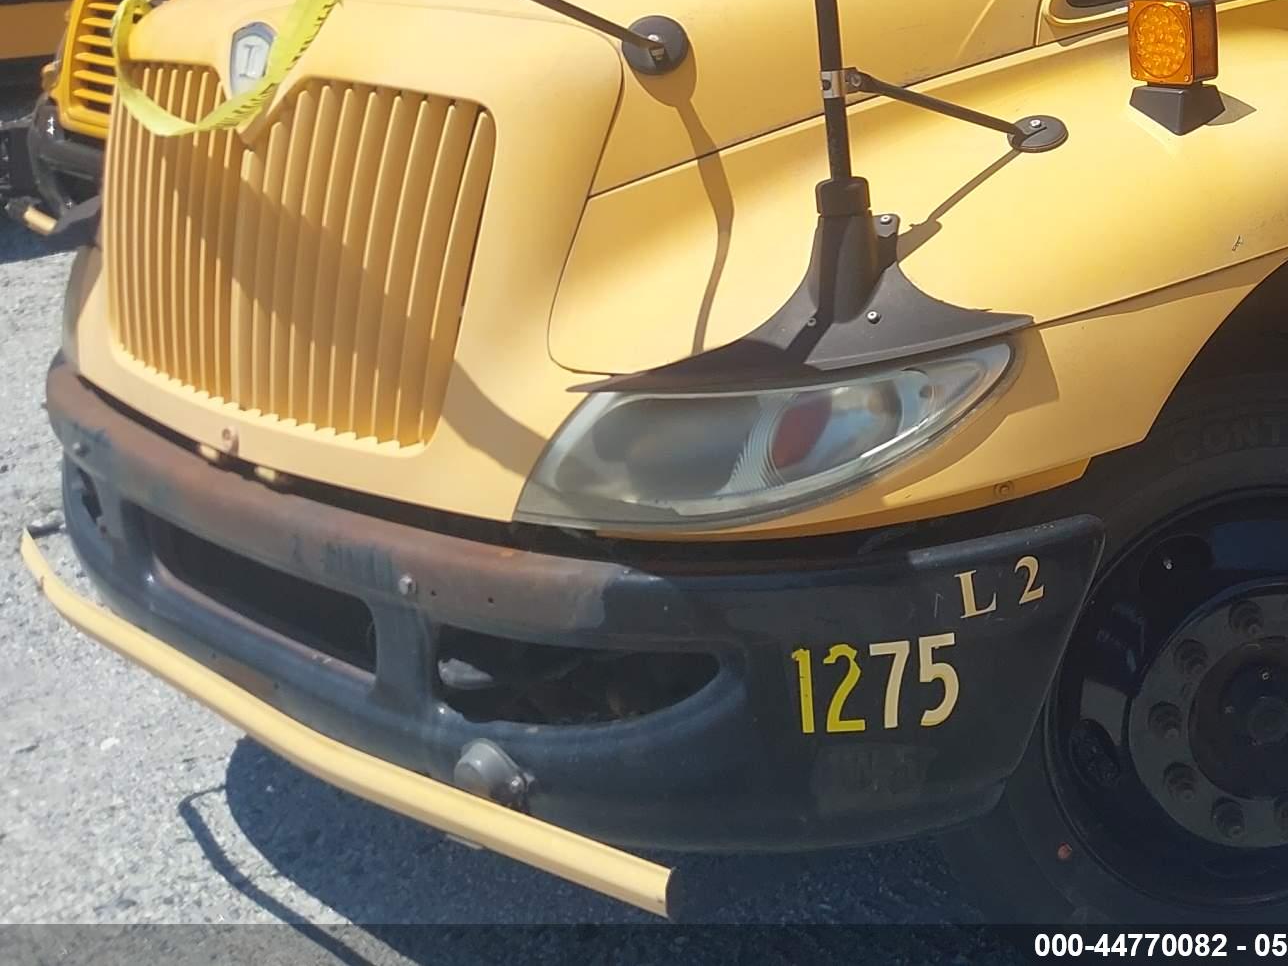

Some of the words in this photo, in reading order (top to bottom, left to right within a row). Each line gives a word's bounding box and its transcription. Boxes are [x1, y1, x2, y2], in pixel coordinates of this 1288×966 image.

[954, 569, 997, 619] L
[1014, 555, 1045, 605] 2
[791, 632, 960, 734] 1275
